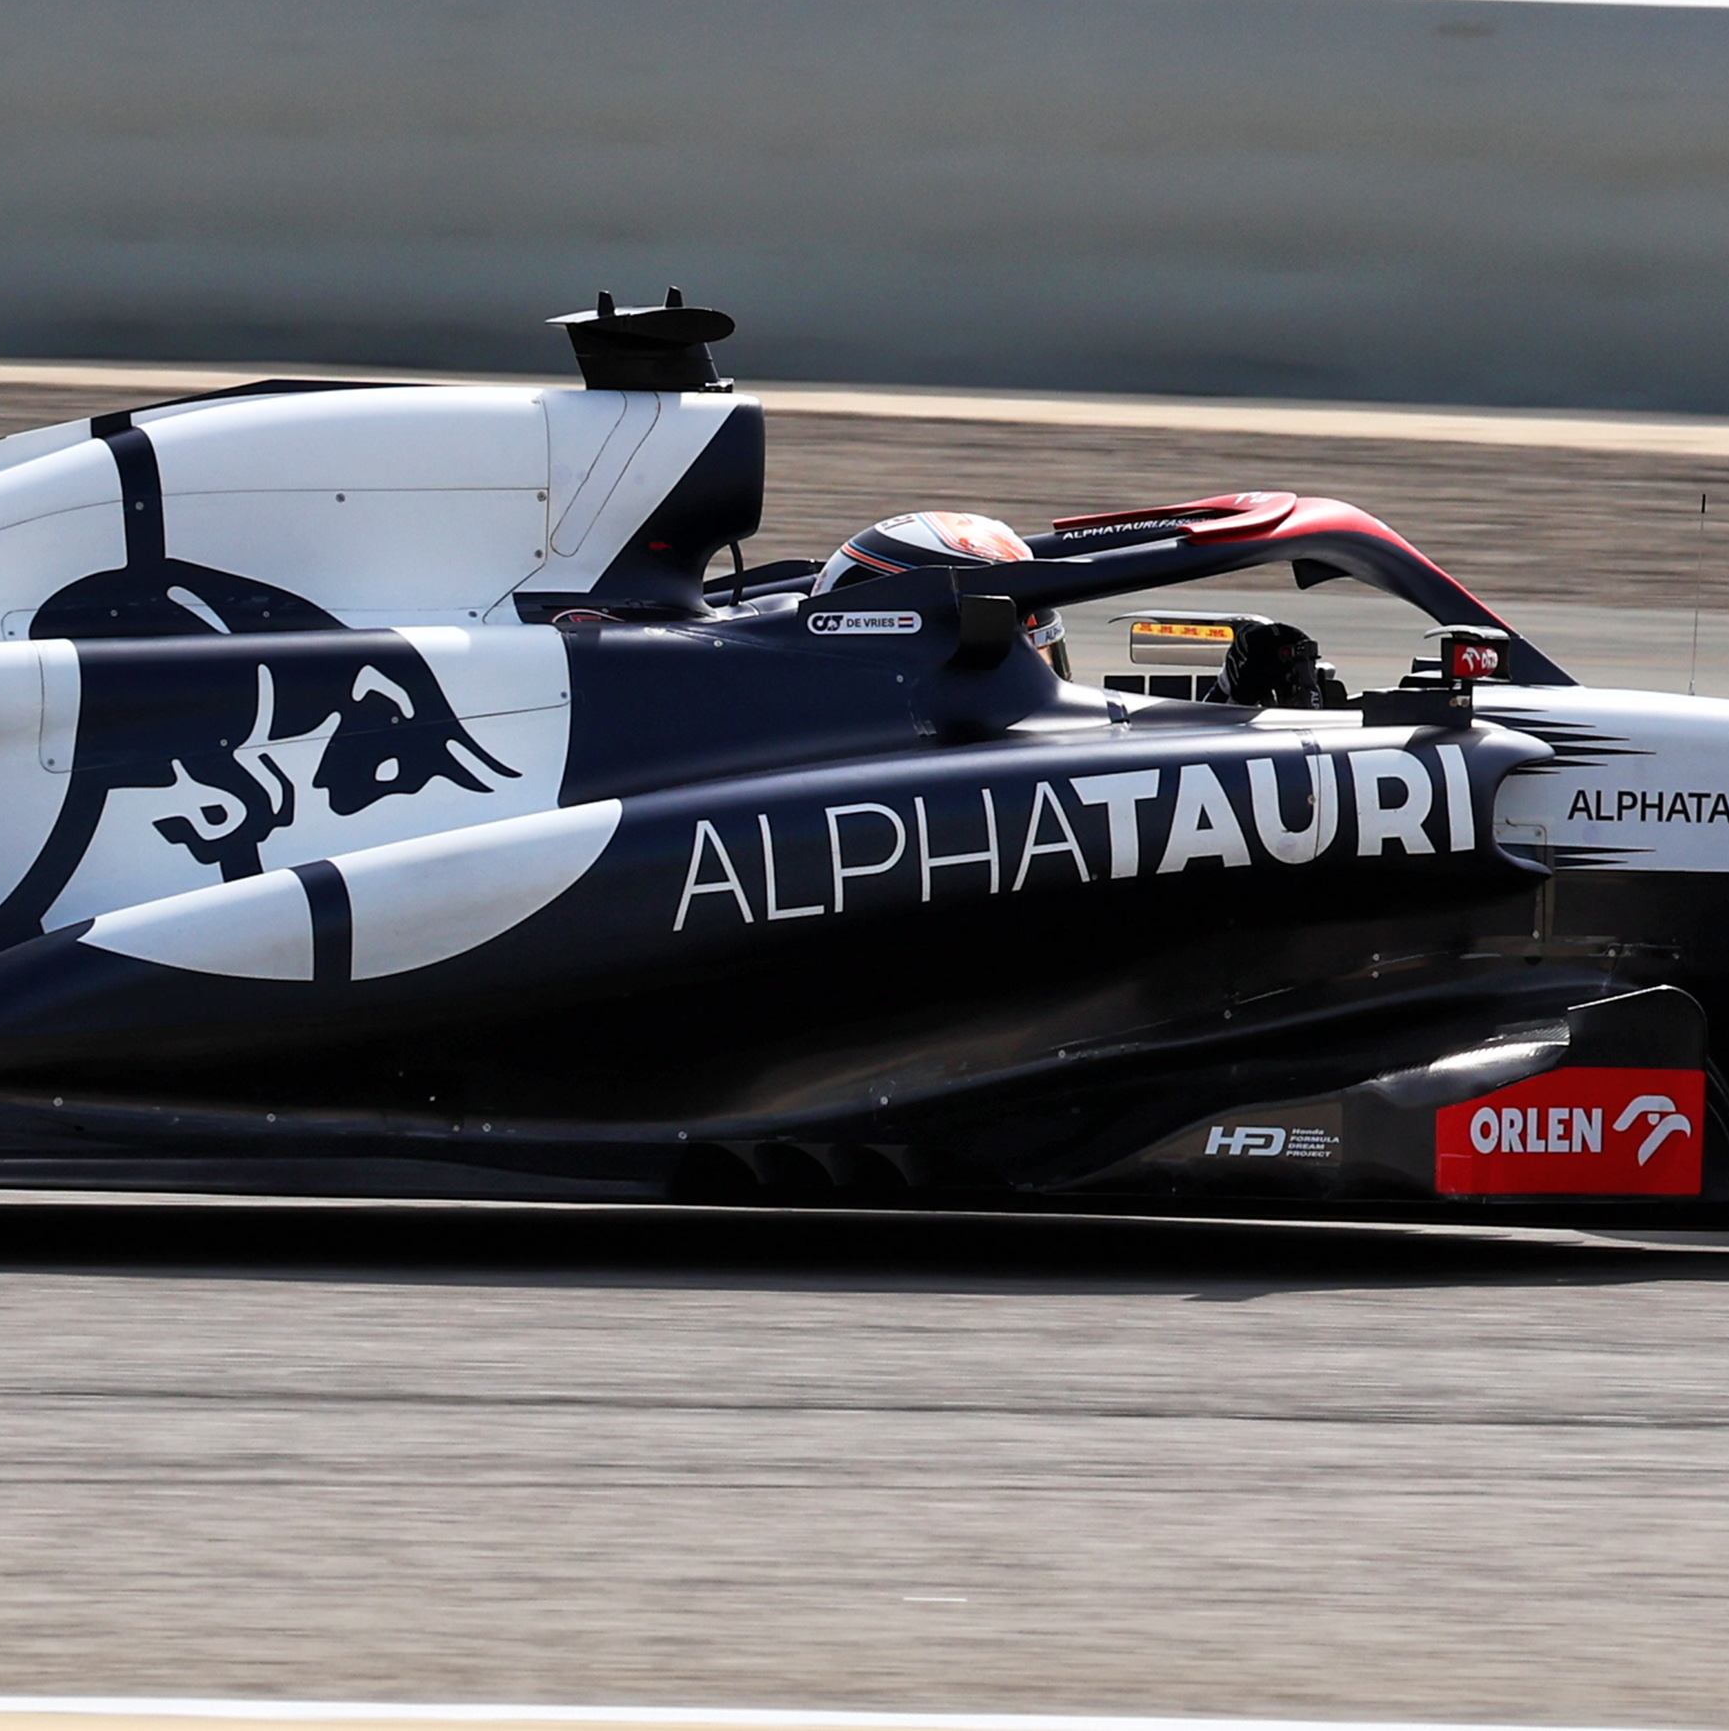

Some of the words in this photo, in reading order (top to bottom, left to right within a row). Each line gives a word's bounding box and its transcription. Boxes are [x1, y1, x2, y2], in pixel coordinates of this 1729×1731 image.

[846, 617, 862, 628] DE
[863, 617, 895, 629] VRIES
[672, 744, 1477, 932] ALPHATAURI
[1470, 1106, 1603, 1154] ORLEN
[1290, 1135, 1340, 1144] FORMULA
[1285, 1150, 1332, 1158] PROJECT
